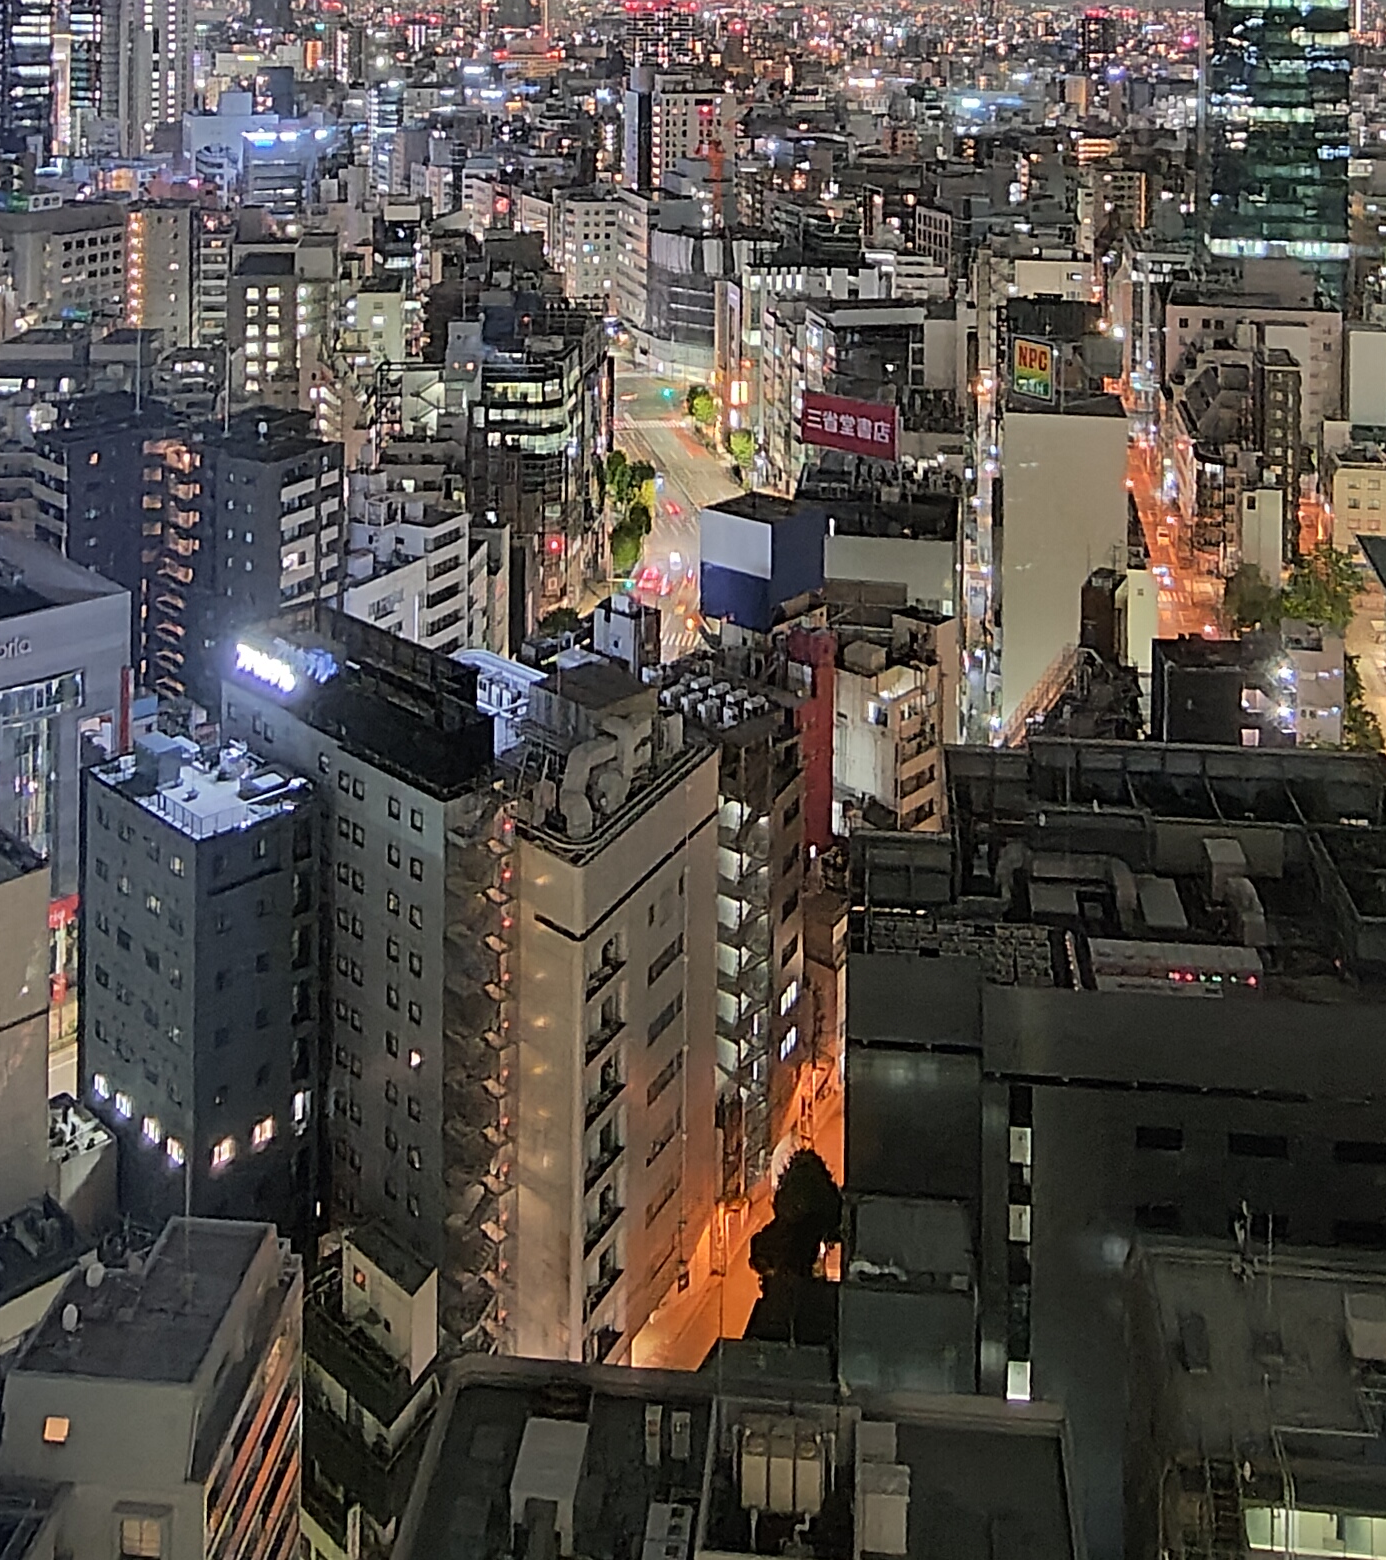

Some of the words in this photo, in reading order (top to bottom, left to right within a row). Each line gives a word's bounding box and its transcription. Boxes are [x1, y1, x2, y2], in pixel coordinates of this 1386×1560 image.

[1018, 345, 1048, 371] NPC
[806, 408, 891, 444] 三省堂書店
